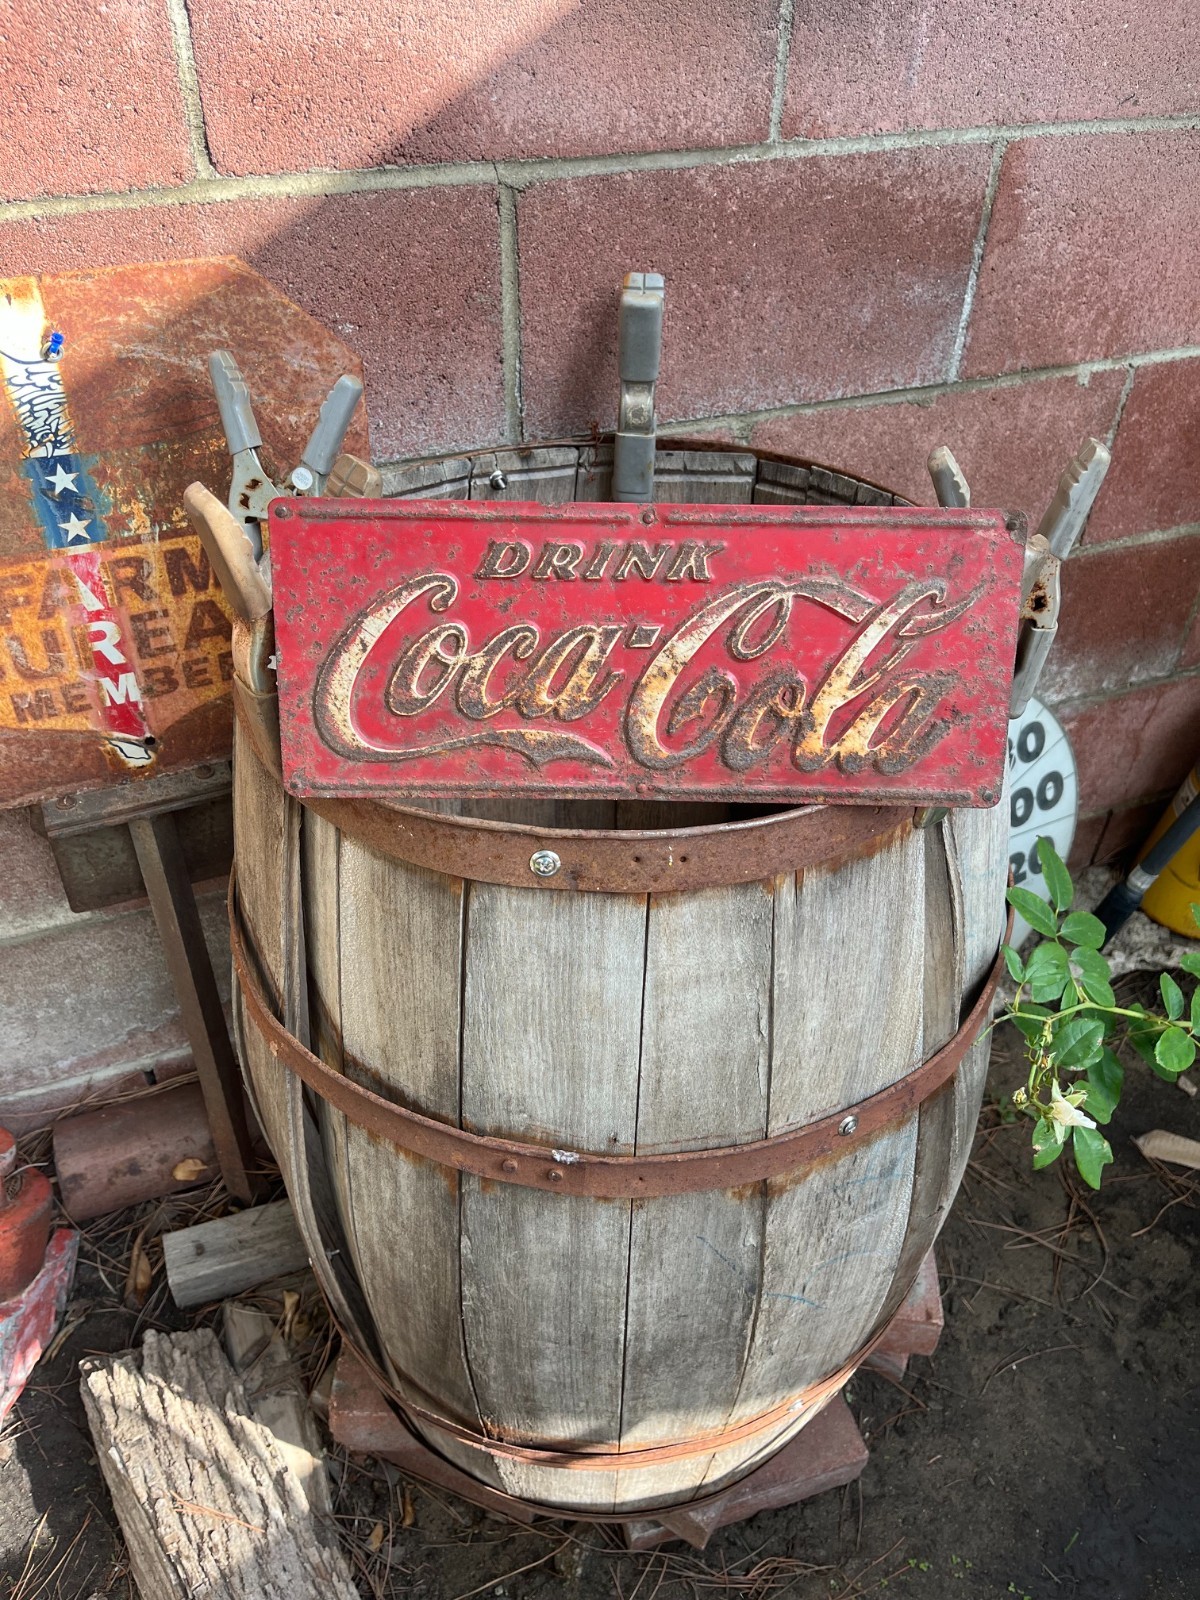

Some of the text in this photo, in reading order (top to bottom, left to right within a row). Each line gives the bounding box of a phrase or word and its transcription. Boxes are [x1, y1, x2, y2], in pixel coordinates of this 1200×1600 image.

[0, 545, 222, 626] FARM
[475, 536, 728, 582] DRINK
[0, 600, 233, 681] UREA
[312, 572, 987, 775] Coca-Cola
